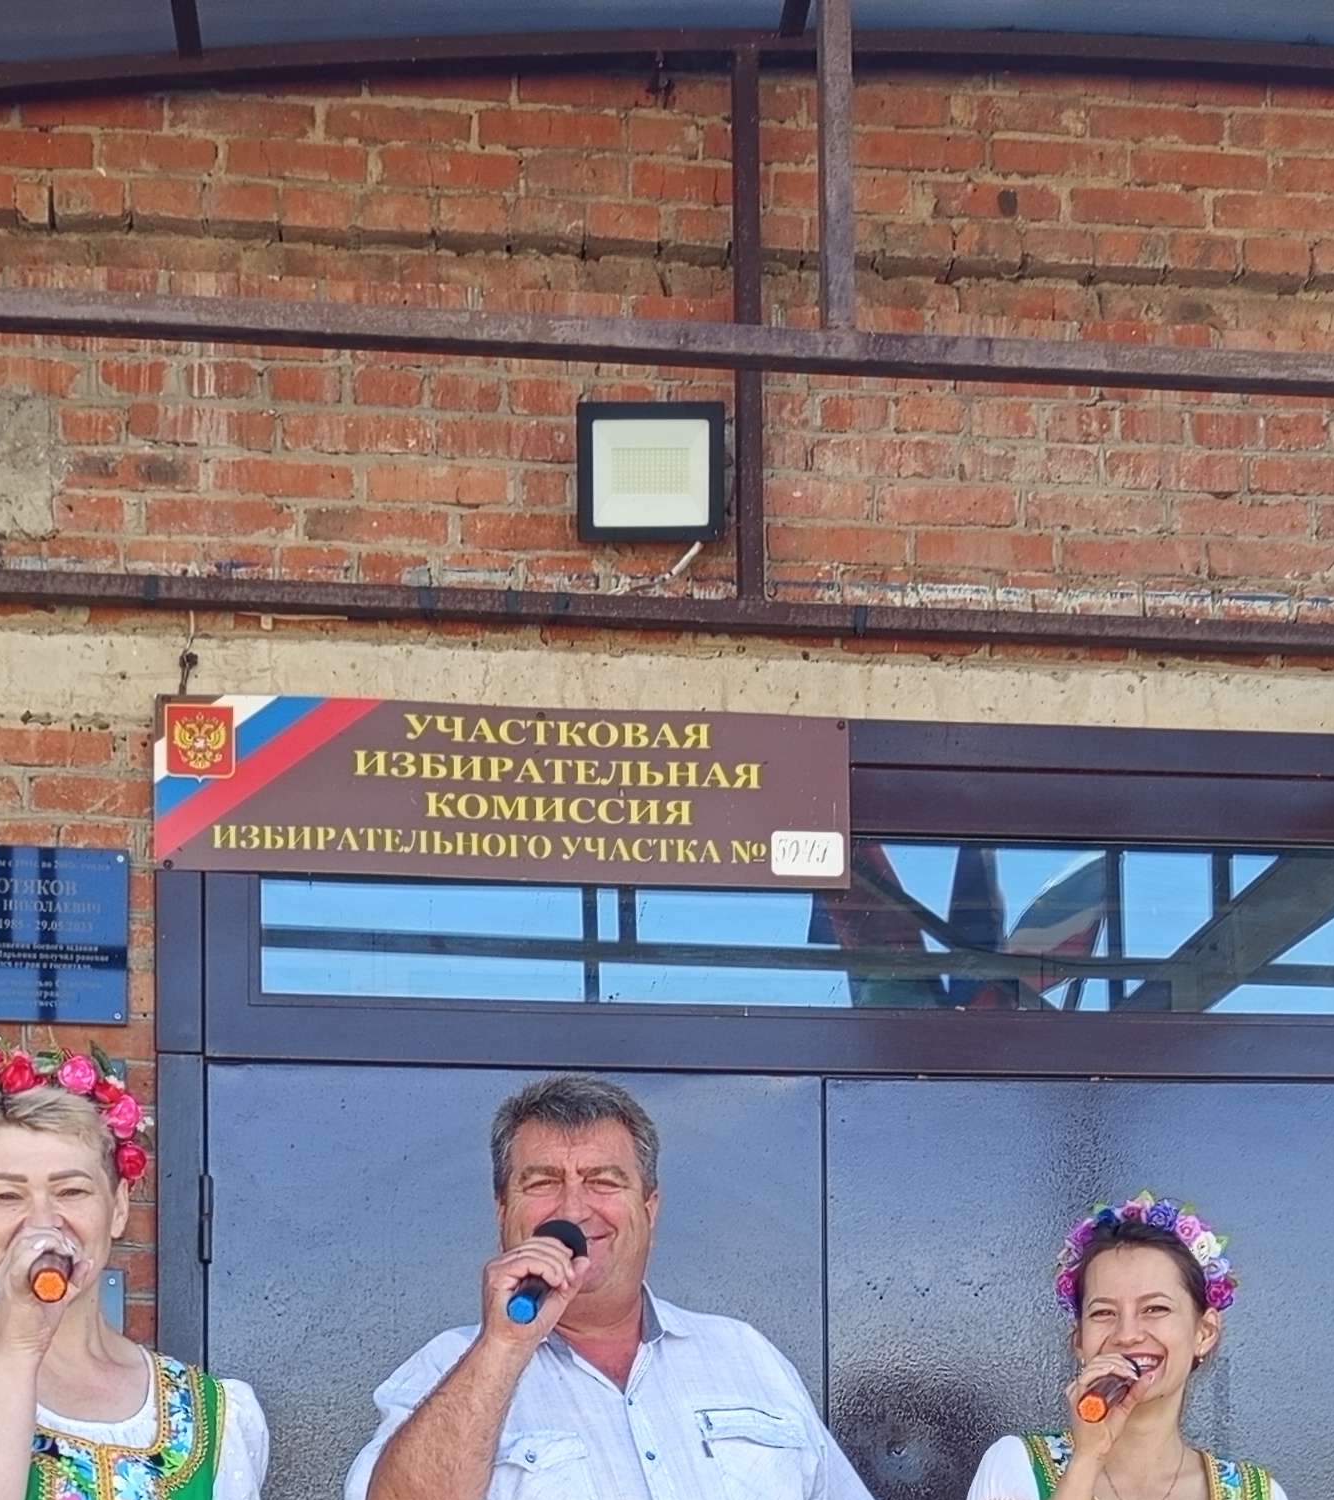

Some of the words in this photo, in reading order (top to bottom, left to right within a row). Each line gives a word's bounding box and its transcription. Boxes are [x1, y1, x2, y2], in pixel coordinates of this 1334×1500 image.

[404, 713, 713, 750] УЧАСТКОВАЯ
[353, 749, 763, 790] ИЗБИРАТЕЛЬНАЯ
[424, 791, 694, 826] КОМИССИЯ
[212, 824, 552, 861] ИЗБИРАТЕЛЬНОГО
[562, 836, 722, 865] УЧАСТКА
[730, 840, 767, 864] №
[3, 899, 101, 914] НИКОЛАЕВИЧ
